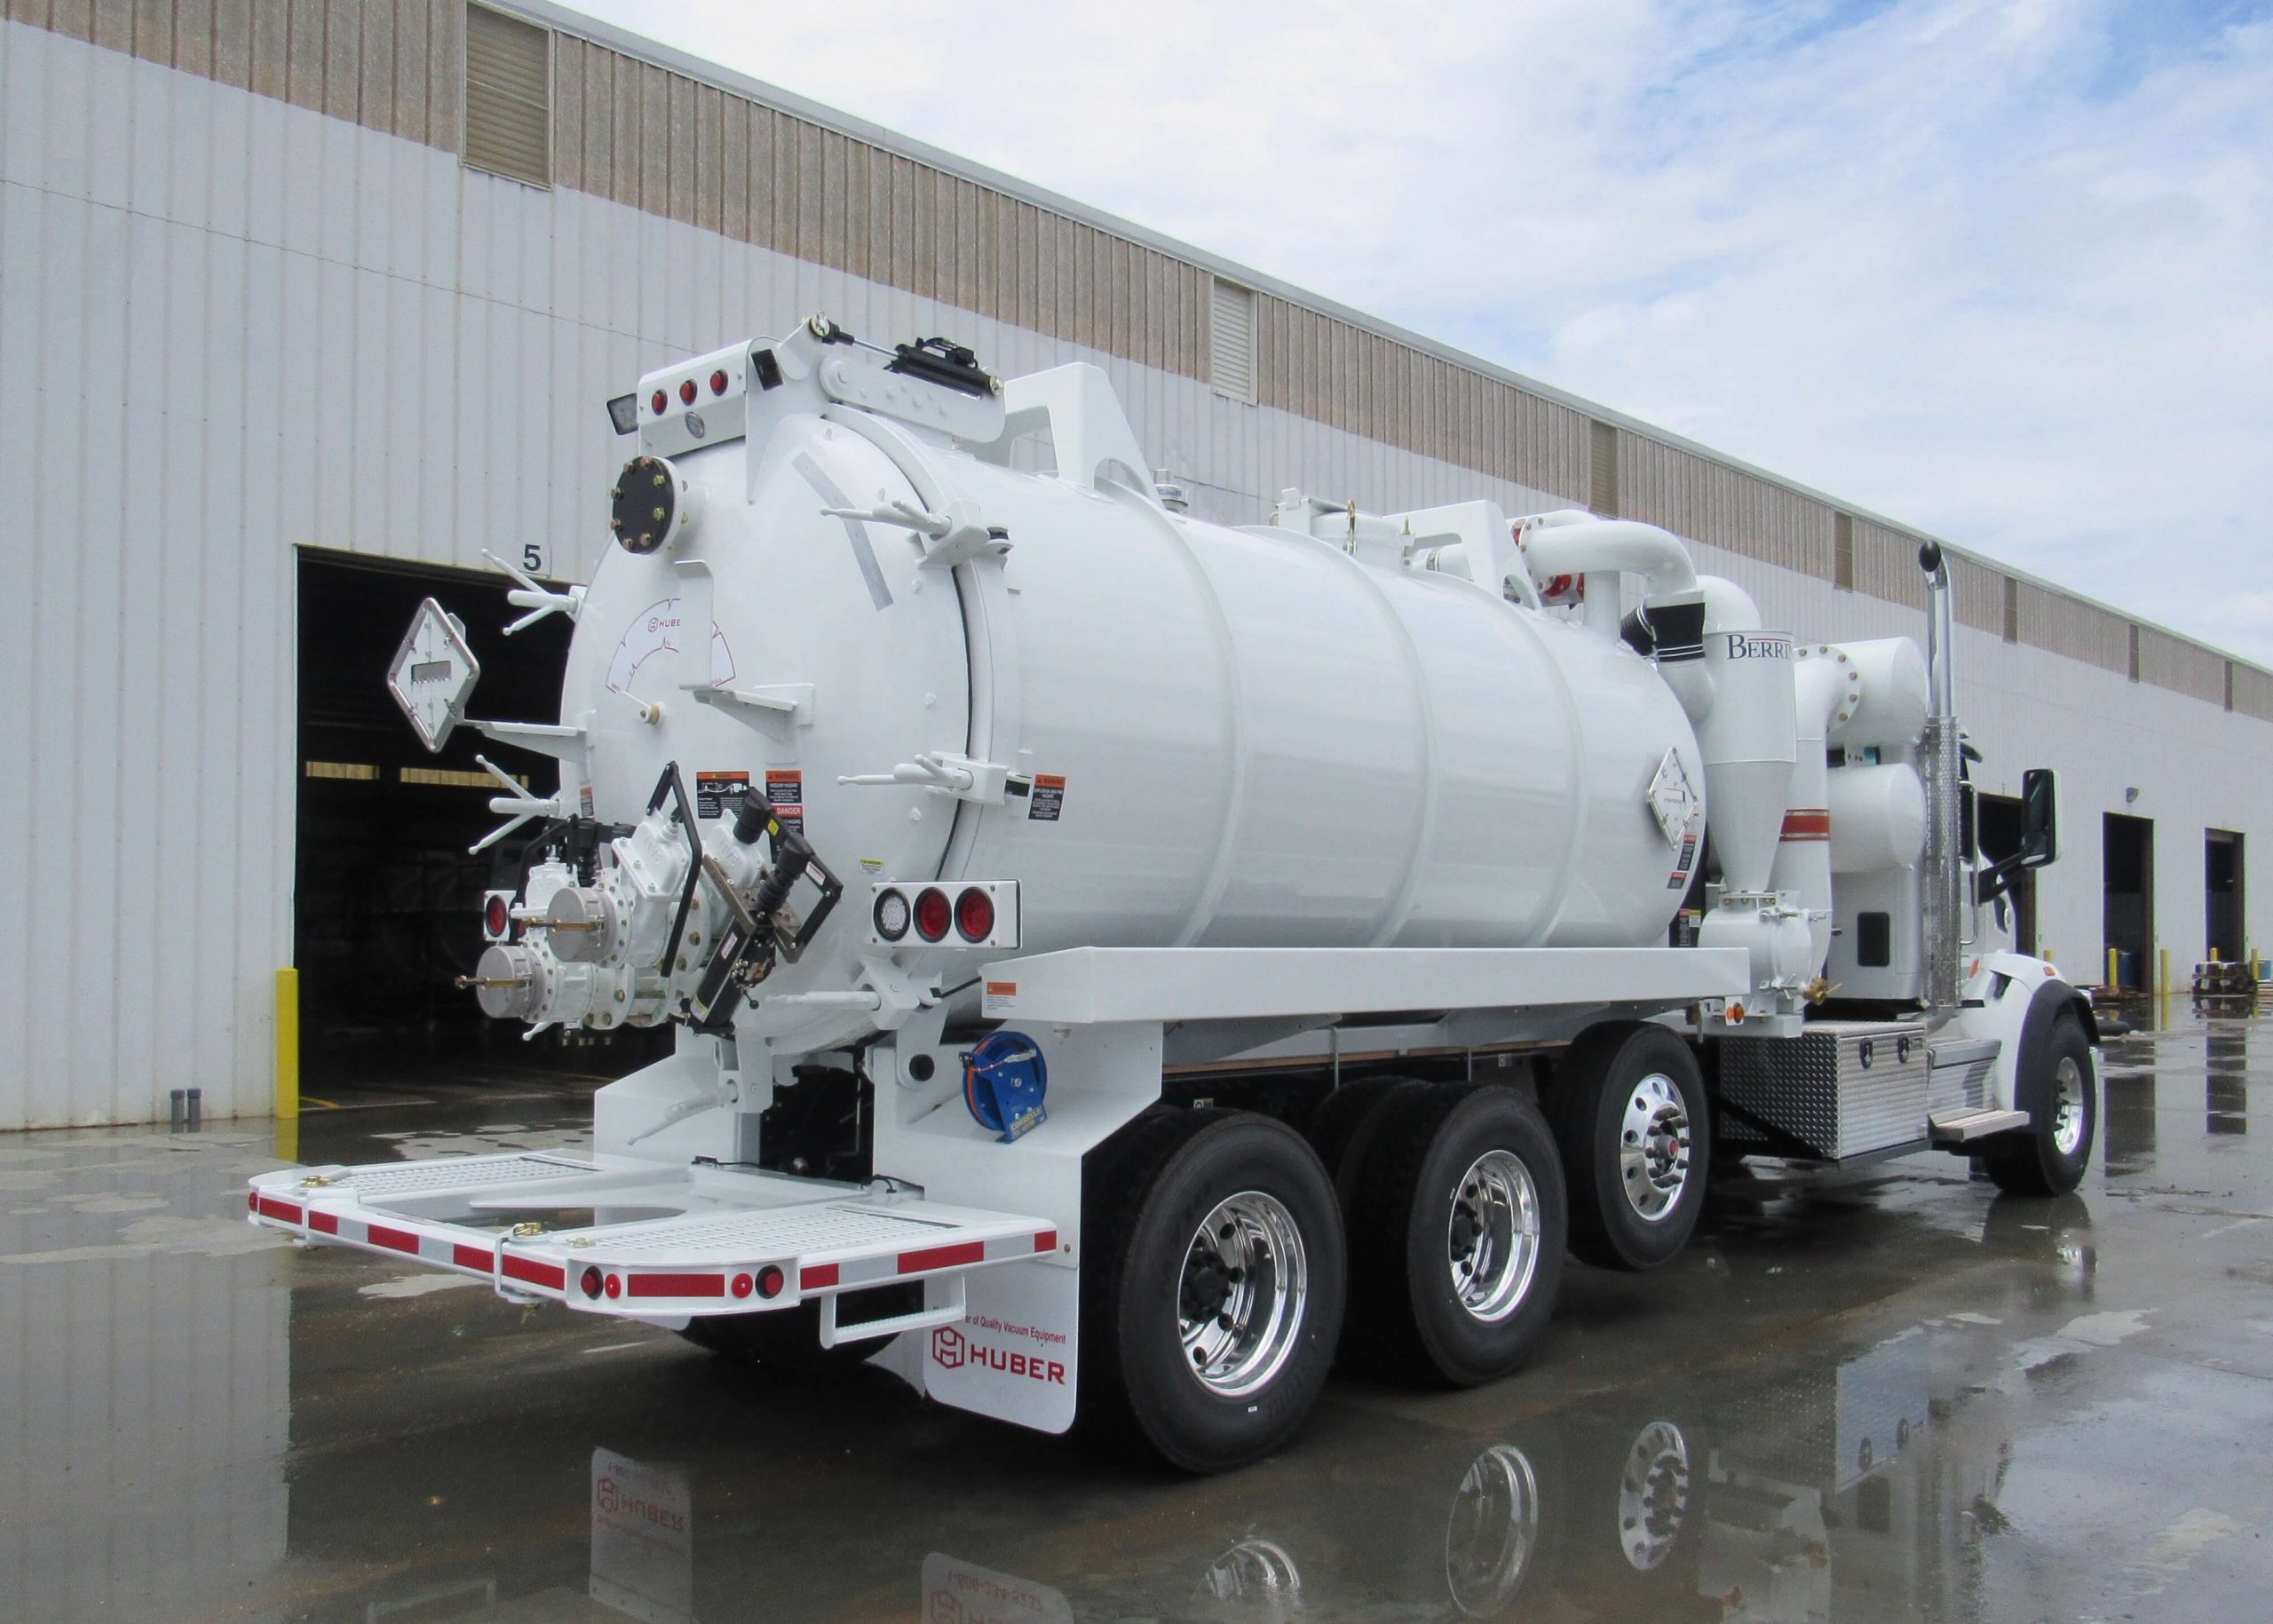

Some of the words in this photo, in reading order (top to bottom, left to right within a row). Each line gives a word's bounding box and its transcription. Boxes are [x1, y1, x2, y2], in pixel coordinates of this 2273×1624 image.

[523, 543, 542, 572] 5
[659, 618, 681, 627] HUBE
[972, 1315, 980, 1325] of
[980, 1316, 1002, 1333] Quality
[1004, 1321, 1029, 1336] Vacuum
[1030, 1327, 1066, 1344] Equipment
[970, 1343, 1066, 1385] HUBER
